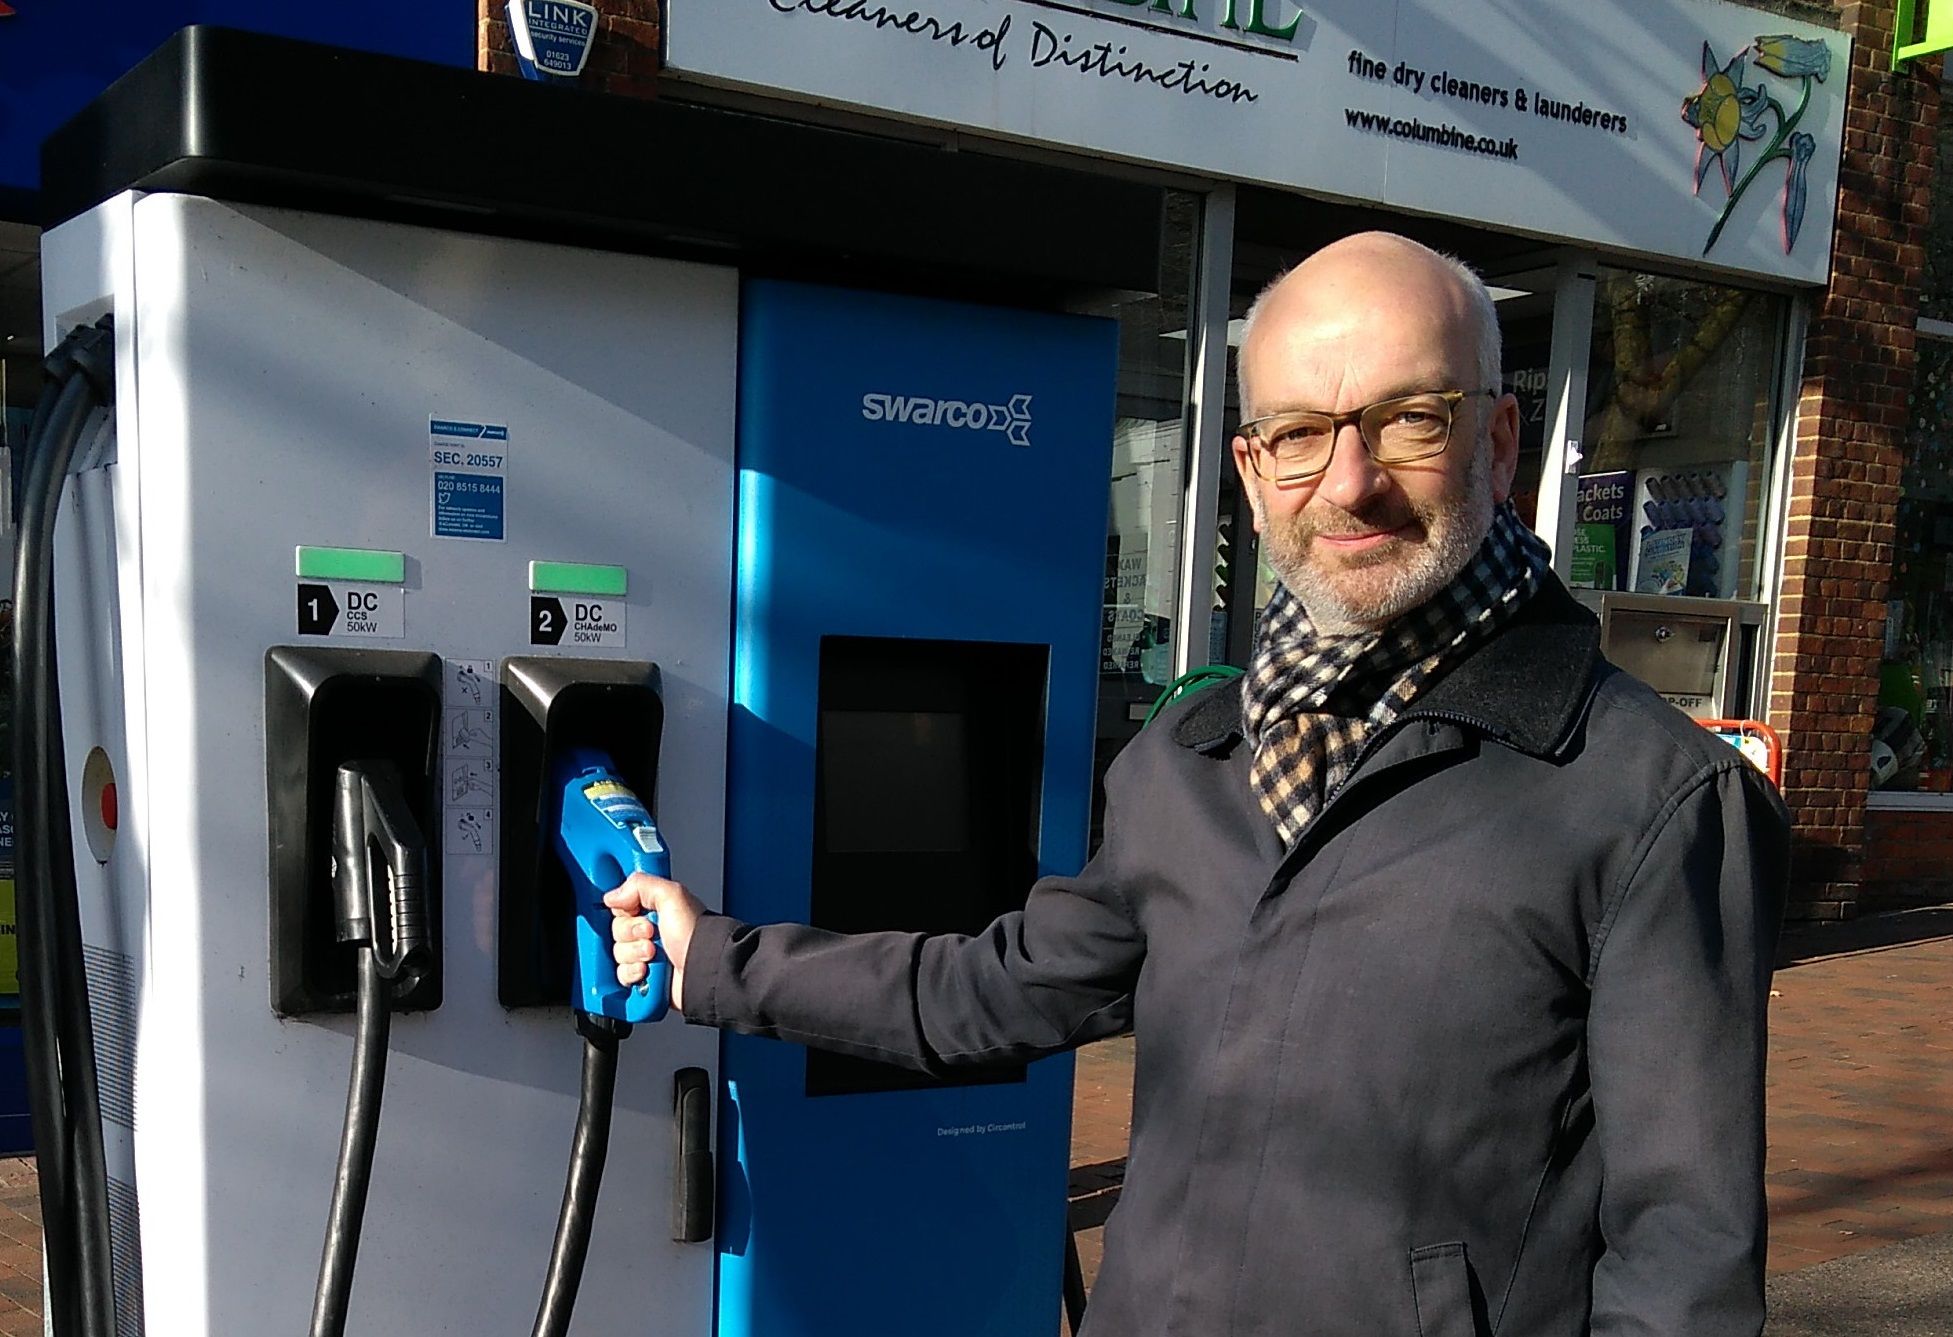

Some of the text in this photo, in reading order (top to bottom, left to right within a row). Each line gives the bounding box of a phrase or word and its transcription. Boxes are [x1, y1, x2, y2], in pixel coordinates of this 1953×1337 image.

[528, 1, 588, 27] LINK
[528, 18, 588, 35] INTEGRATED
[530, 31, 586, 47] security services
[546, 50, 570, 61] 01623
[768, 0, 969, 46] eaners
[1031, 20, 1259, 102] Distinction
[1347, 50, 1628, 133] fine dry cleaners & launderers
[1344, 108, 1519, 160] www.columbine.co.uk
[433, 451, 503, 468] SEC. 20557
[437, 481, 501, 494] 020 8515 8444
[1577, 484, 1625, 502] ackets
[1582, 505, 1624, 521] Coats
[307, 598, 318, 621] 1
[347, 592, 378, 611] DC
[346, 611, 368, 620] CCS
[538, 610, 552, 632] 2
[575, 603, 603, 622] DC
[347, 621, 378, 632] 50kW
[574, 622, 618, 632] CHAdeMO
[574, 632, 602, 642] 50kW
[937, 1125, 975, 1136] Designed
